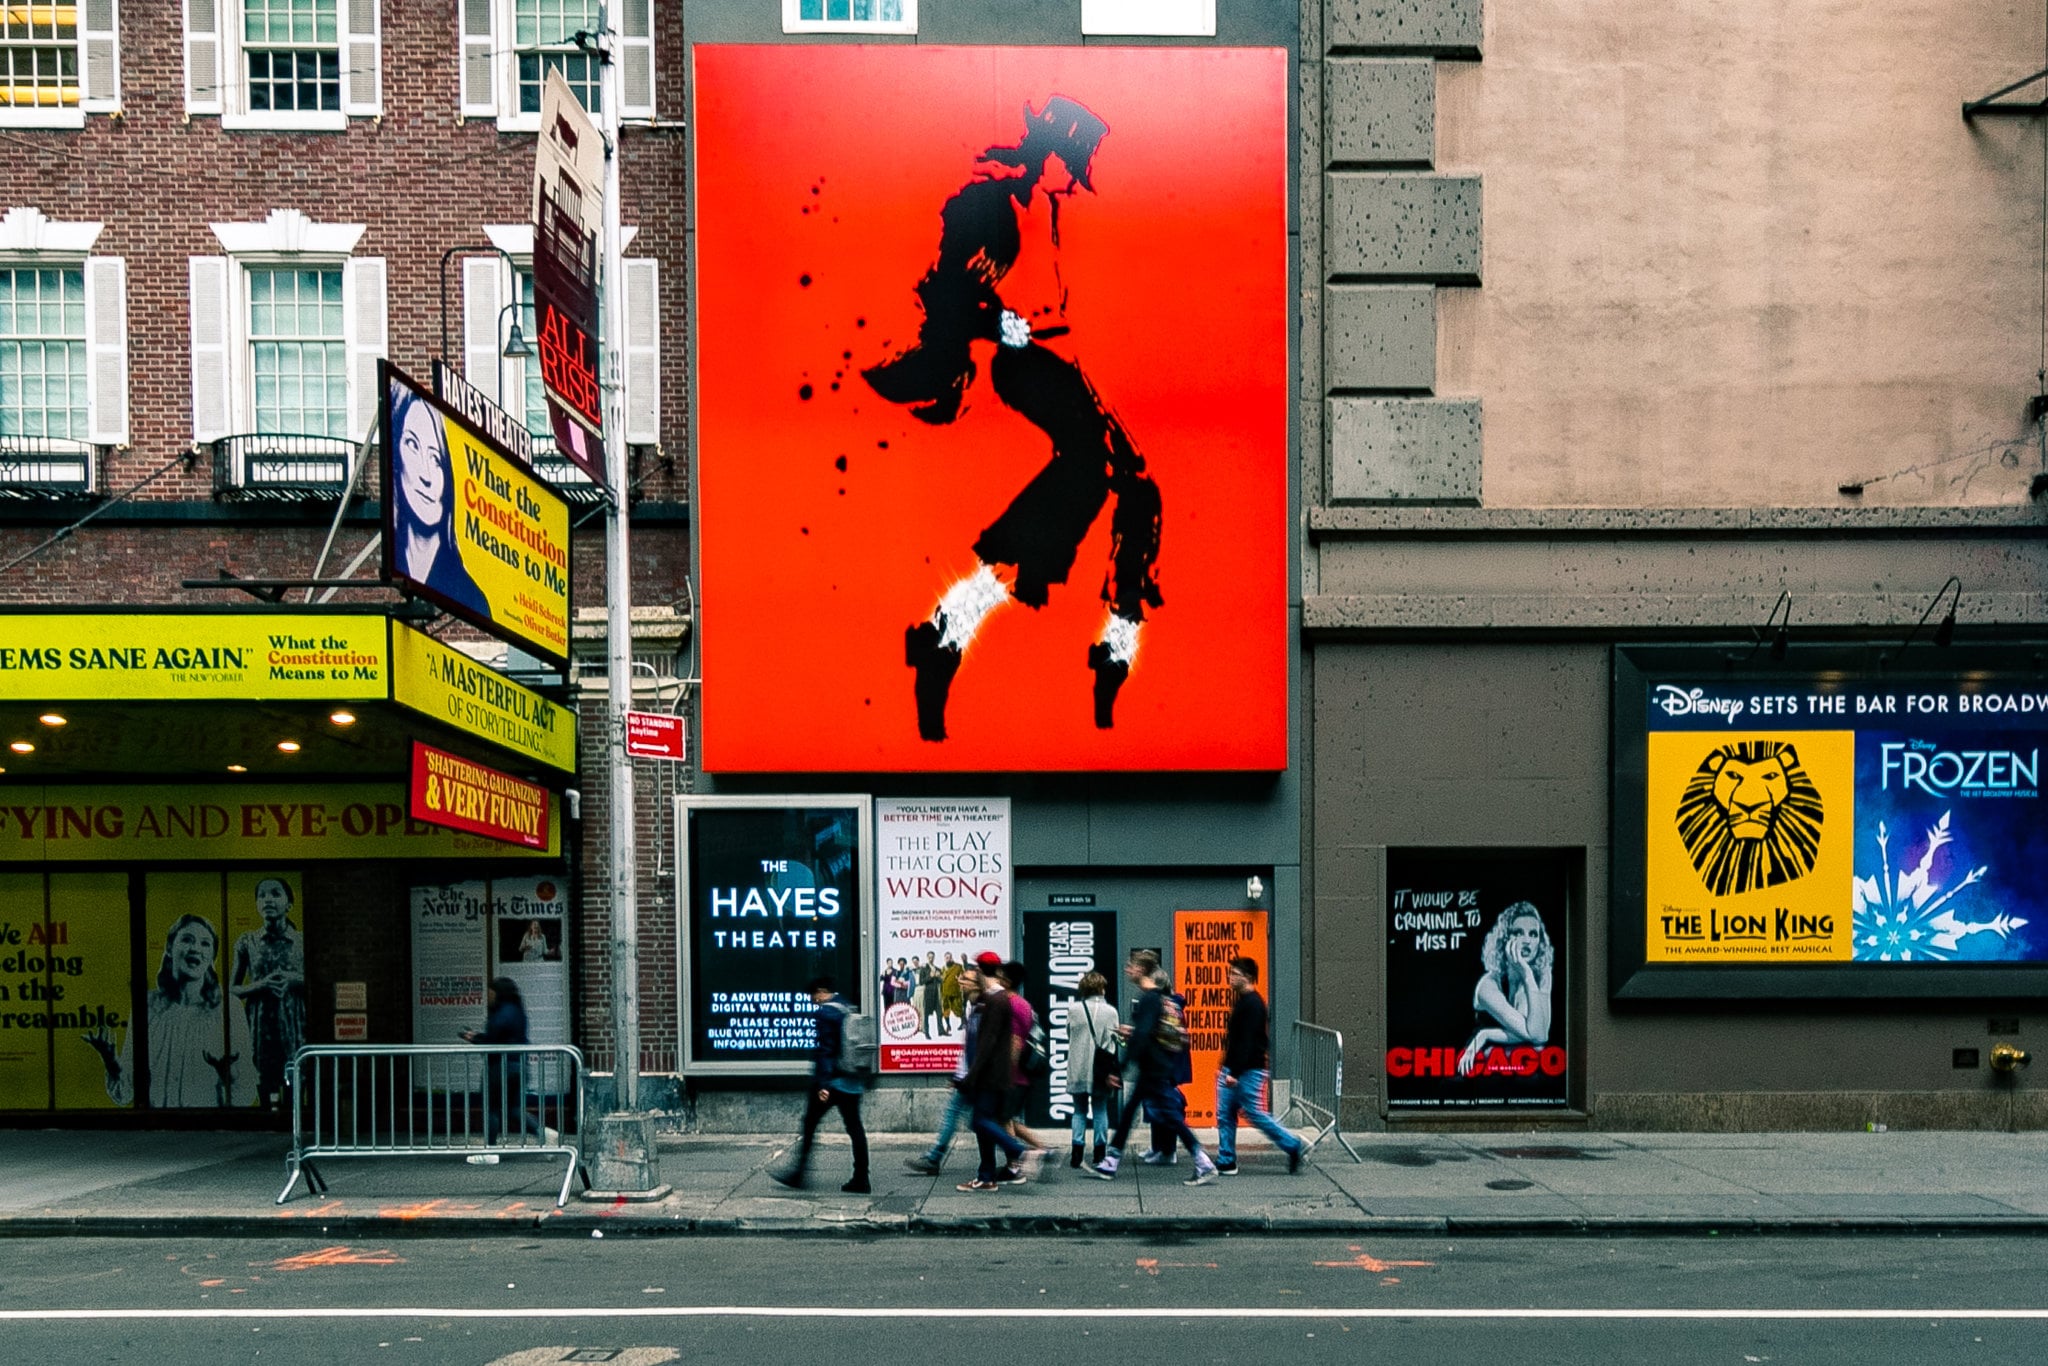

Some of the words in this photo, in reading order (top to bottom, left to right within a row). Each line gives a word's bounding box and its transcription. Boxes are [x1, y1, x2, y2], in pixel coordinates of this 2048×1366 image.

[542, 304, 594, 380] ALL
[539, 335, 600, 425] RISE
[441, 363, 483, 428] HAYES
[483, 397, 533, 466] THEATER
[464, 443, 511, 502] What
[516, 486, 541, 522] the
[464, 478, 567, 569] Constitution
[465, 510, 520, 570] Means
[524, 553, 541, 582] to
[544, 562, 566, 597] Me
[524, 614, 545, 635] Oliver
[268, 635, 316, 649] What
[322, 635, 348, 649] the
[0, 648, 61, 669] EMS
[69, 648, 147, 669] SANE
[268, 651, 378, 665] Constitution
[269, 667, 326, 680] Means
[331, 667, 349, 680] to
[354, 667, 378, 680] Me
[442, 654, 530, 722] MASTERFUL
[532, 701, 556, 733] ACT
[448, 693, 464, 720] OF
[1750, 696, 1799, 714] SETS
[1807, 695, 1846, 714] THE
[1856, 695, 1897, 713] BAR
[1907, 695, 1949, 713] FOR
[629, 716, 640, 725] NO
[641, 717, 675, 729] STANDING
[631, 726, 659, 737] Anytime
[1881, 743, 2038, 797] FROZEN
[426, 774, 441, 811] &
[443, 778, 489, 823] VERY
[489, 774, 541, 806] GALVANIZING
[884, 814, 919, 822] BETTER
[921, 814, 942, 822] TIME
[930, 805, 957, 813] NEVER
[958, 805, 980, 813] HAVE
[134, 805, 230, 838] AND
[895, 836, 931, 851] THE
[936, 831, 992, 851] PLAY
[761, 860, 788, 872] THE
[886, 855, 934, 871] THAT
[937, 853, 1002, 874] GOES
[438, 888, 464, 902] The
[886, 876, 1003, 905] WRONG
[1394, 888, 1412, 910] IT
[1412, 890, 1454, 909] WOULD
[1458, 889, 1480, 907] BE
[422, 897, 460, 917] New
[465, 897, 508, 921] York
[511, 896, 564, 915] Times
[711, 887, 840, 917] HAYES
[1394, 911, 1464, 931] CRIMINAL
[1464, 909, 1481, 928] TO
[1661, 916, 1702, 935] THE
[1711, 908, 1767, 941] LION
[1775, 908, 1834, 941] KING
[27, 921, 69, 945] All
[714, 931, 837, 948] THEATER
[900, 929, 977, 938] GUT-BUSTING
[1049, 922, 1069, 957] YEARS
[1070, 921, 1094, 955] BOLD
[1185, 922, 1237, 941] WELCOME
[1241, 922, 1253, 940] TO
[1415, 931, 1447, 952] MISS
[1451, 932, 1467, 950] IT
[1185, 944, 1204, 963] THE
[1207, 944, 1240, 963] HAYES
[1664, 946, 1682, 954] THE
[1685, 946, 1767, 954] AWARD-WINNING
[1770, 946, 1790, 954] BEST
[1792, 946, 1833, 954] MUSICAL
[0, 949, 84, 976] elong
[1049, 957, 1094, 990] 40
[1185, 966, 1192, 985] A
[1195, 966, 1222, 985] BOLD
[18, 978, 65, 1000] the
[712, 993, 728, 1002] TO
[731, 993, 792, 1002] ADVERTISE
[795, 993, 812, 1002] ON
[1185, 988, 1198, 1007] OF
[420, 996, 482, 1005] IMPORTANT
[712, 1003, 756, 1013] DIGITAL
[760, 1003, 791, 1013] WALL
[0, 1005, 129, 1029] reamble.
[730, 1018, 770, 1027] PLEASE
[708, 1029, 733, 1038] BLUE
[735, 1029, 761, 1038] VISTA
[763, 1029, 780, 1038] 725
[1386, 1045, 1567, 1079] CHICAGO
